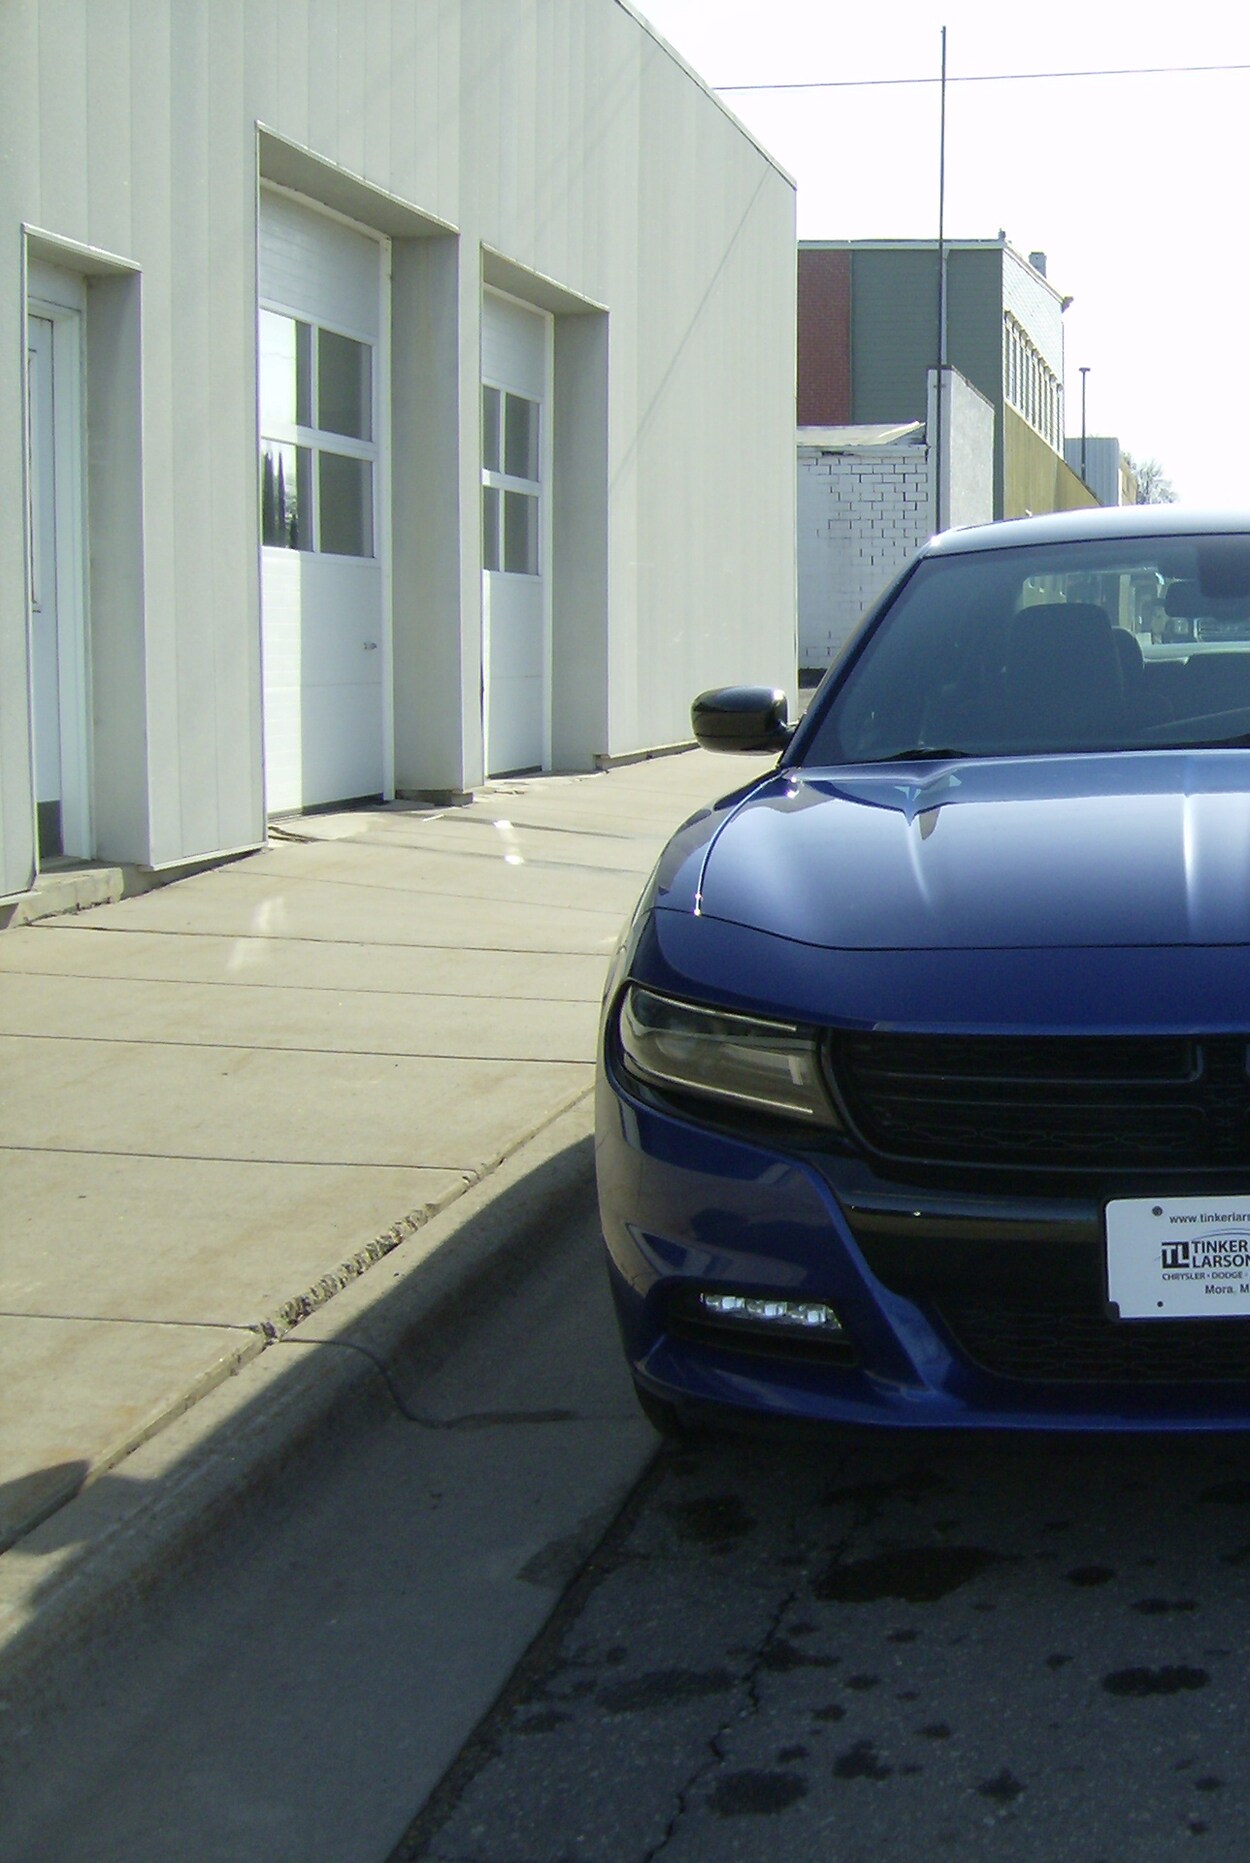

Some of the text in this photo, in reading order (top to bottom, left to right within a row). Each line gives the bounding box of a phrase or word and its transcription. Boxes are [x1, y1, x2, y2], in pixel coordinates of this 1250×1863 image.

[1191, 1240, 1248, 1254] TINKER
[1162, 1272, 1205, 1281] CHRYSLER
[1211, 1271, 1243, 1280] DODGE
